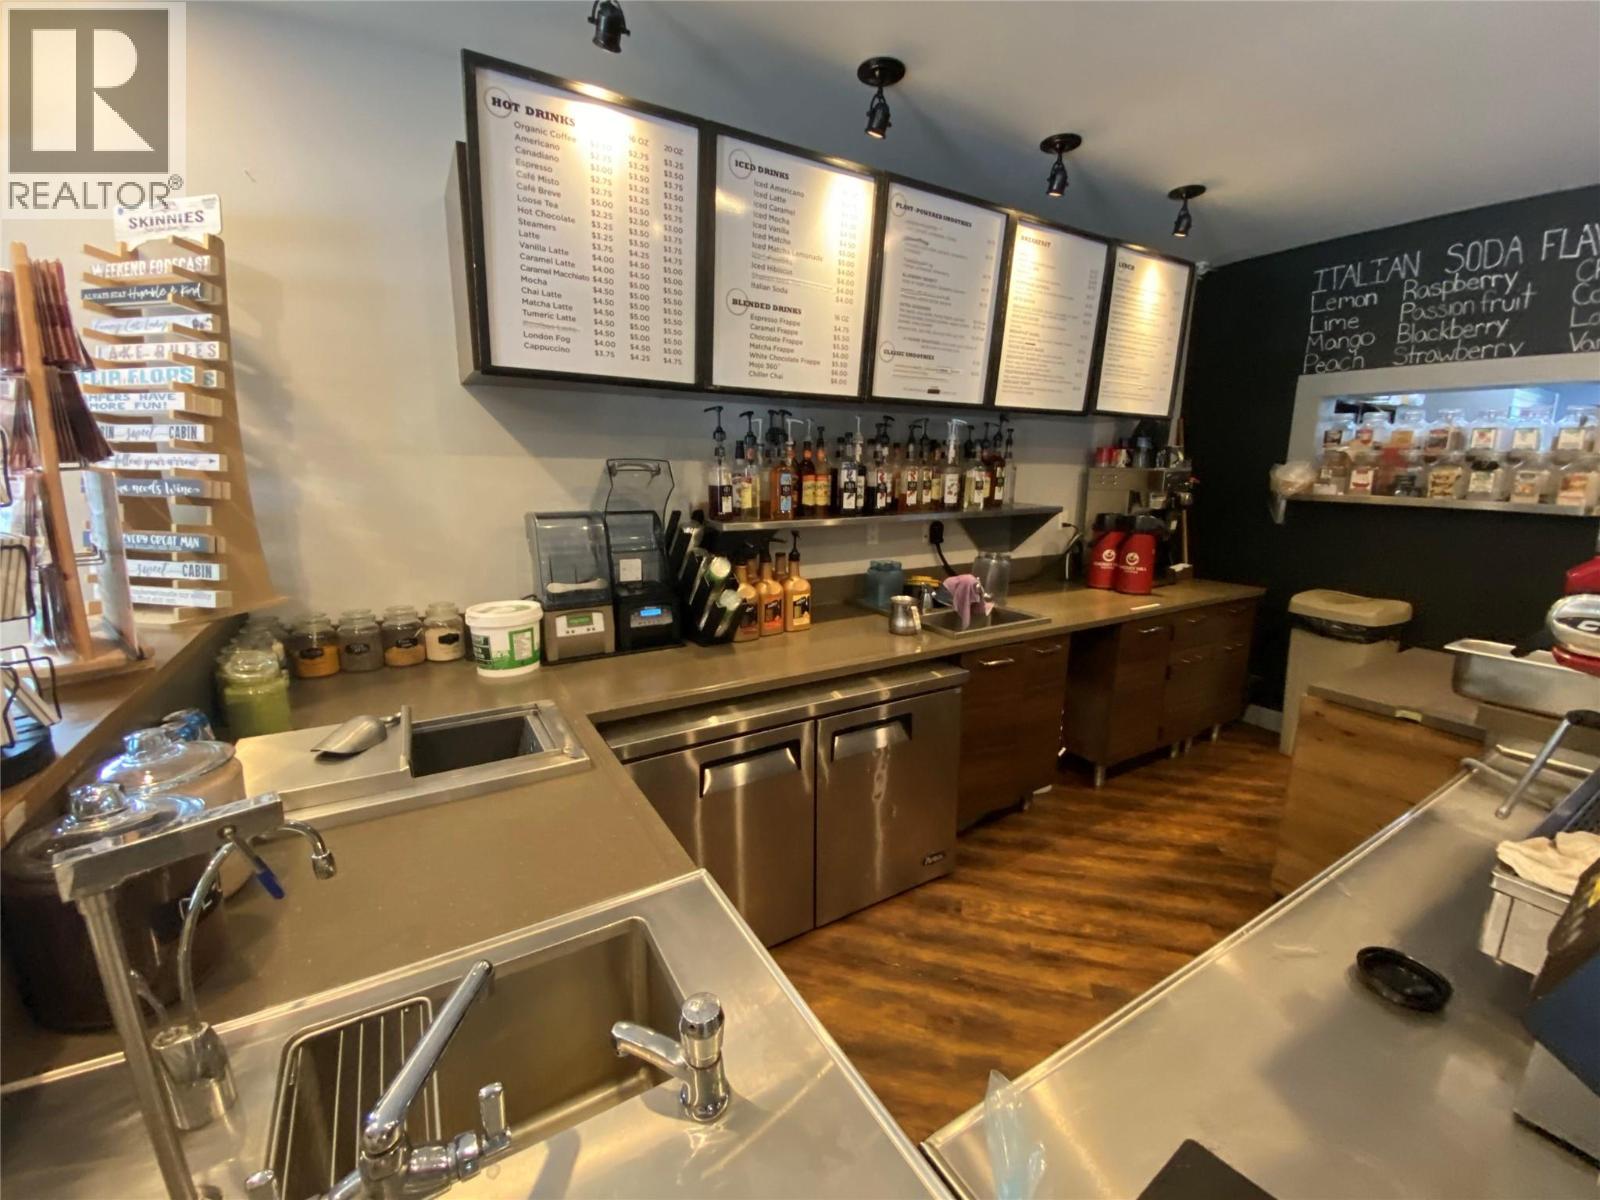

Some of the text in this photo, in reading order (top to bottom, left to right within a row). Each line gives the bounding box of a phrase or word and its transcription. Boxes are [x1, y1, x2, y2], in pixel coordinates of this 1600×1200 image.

[491, 96, 576, 127] HOT DRINKS
[514, 121, 576, 143] Organic Coffee
[515, 134, 560, 151] Americano
[638, 138, 649, 146] OZ
[515, 146, 560, 162] Canadiano
[629, 150, 648, 161] $2.75
[664, 144, 684, 156] 20 OZ
[516, 158, 552, 173] Espresso
[664, 159, 684, 170] $3.25
[735, 159, 790, 180] ICED DRINKS
[516, 170, 560, 186] Café Misto
[629, 172, 649, 183] $3.50
[516, 182, 561, 198] Café Breve
[664, 181, 683, 192] $3.75
[754, 179, 804, 198] Iced Americano
[517, 194, 558, 209] Loose Tea
[591, 198, 614, 208] $5.00
[754, 190, 786, 204] Iced Latte
[754, 200, 796, 216] Iced Caramel
[128, 210, 204, 230] SKINNIES
[517, 206, 576, 224] Hot Chocolate
[591, 209, 613, 220] $2.25
[664, 214, 682, 224] $5.75
[753, 211, 790, 226] Iced Mocha
[518, 218, 556, 232] Steamers
[592, 220, 613, 232] $3.25
[629, 217, 649, 227] $2.50
[518, 230, 540, 240] Latte
[664, 224, 683, 234] $3.00
[753, 222, 790, 236] Iced Vanilla
[629, 239, 649, 248] $3.50
[752, 232, 791, 245] Iced Matcha
[519, 241, 569, 256] Vanilla Latte
[592, 242, 613, 253] $3.75
[752, 242, 766, 251] Iced
[520, 252, 576, 268] Caramel Latte
[592, 254, 614, 264] $4.00
[629, 250, 649, 260] $4.25
[1312, 224, 1600, 295] ITALIAN SODA FLA
[91, 260, 146, 278] WEEKEND
[664, 266, 682, 276] $5.00
[752, 262, 766, 271] Iced
[520, 264, 590, 282] Caramel Macchiato
[520, 275, 548, 286] Mocha
[592, 276, 614, 286] $4.50
[630, 282, 650, 290] $5.00
[1402, 271, 1518, 300] Raspberry
[110, 290, 126, 298] STAY
[128, 286, 167, 300] Humble
[180, 282, 201, 298] Kind
[521, 286, 562, 298] Chai Latte
[750, 282, 788, 294] Italian Soda
[522, 298, 574, 311] Matcha Latte
[664, 298, 682, 306] $5.50
[732, 298, 802, 315] BLENDED DRINKS
[1311, 292, 1378, 314] Lemon
[522, 308, 576, 322] Tumeric Latte
[750, 314, 778, 324] Espresso
[750, 324, 776, 333] Caramel
[1310, 314, 1360, 334] Lime
[523, 330, 571, 344] London Fog
[1396, 318, 1510, 344] Blackberry
[750, 333, 780, 342] Chocolate
[1307, 330, 1376, 356] Mango
[524, 342, 571, 354] Cappuccino
[594, 340, 616, 348] $4.00
[630, 344, 650, 352] $4.50
[750, 342, 772, 352] Matcha
[595, 350, 615, 358] $3.75
[750, 352, 768, 360] White
[1393, 341, 1525, 366] Strawberry
[1303, 354, 1364, 375] Peach
[80, 368, 193, 385] FLIP FLOPS
[86, 393, 130, 401] MPERS
[90, 402, 167, 410] MORE FUN!
[168, 426, 198, 439] CABIN
[180, 536, 200, 548] MAN
[182, 564, 212, 578] CABIN
